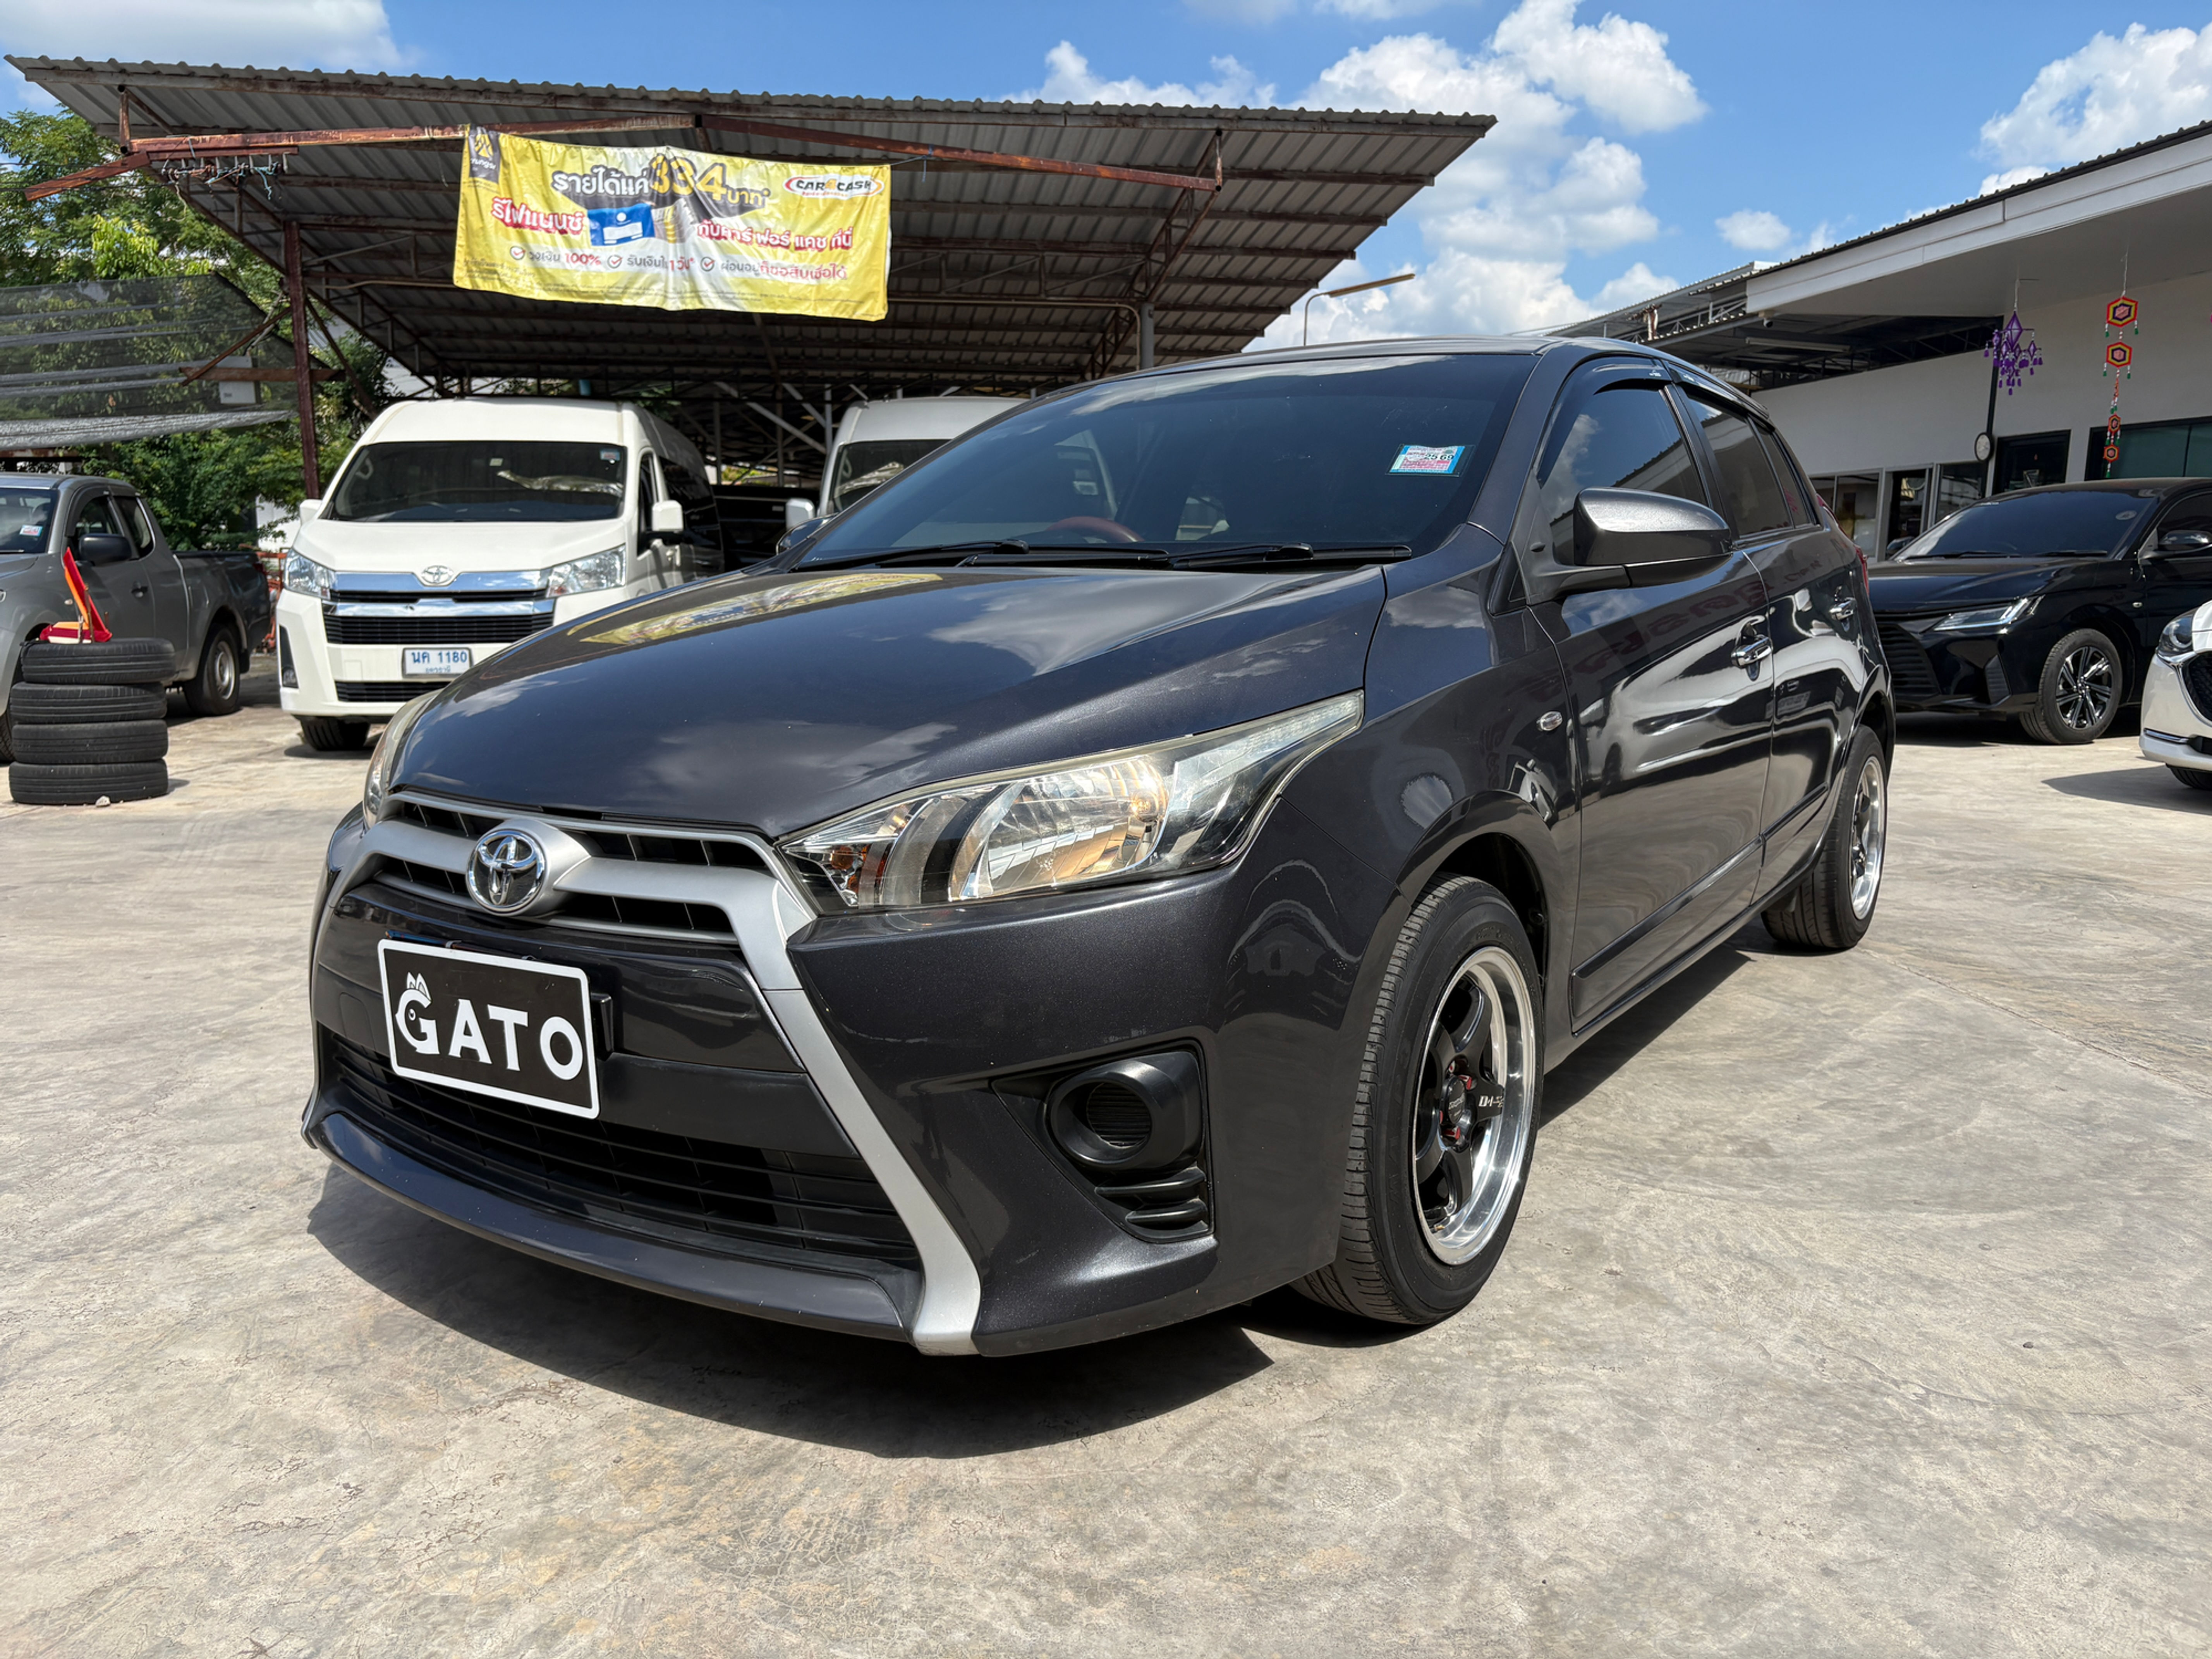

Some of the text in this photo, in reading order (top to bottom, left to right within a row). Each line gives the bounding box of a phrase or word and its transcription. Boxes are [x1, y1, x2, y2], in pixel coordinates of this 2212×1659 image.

[796, 179, 872, 191] CAR4CASH
[565, 252, 601, 265] 100%
[438, 651, 467, 663] 1180
[395, 988, 584, 1080] GATO
